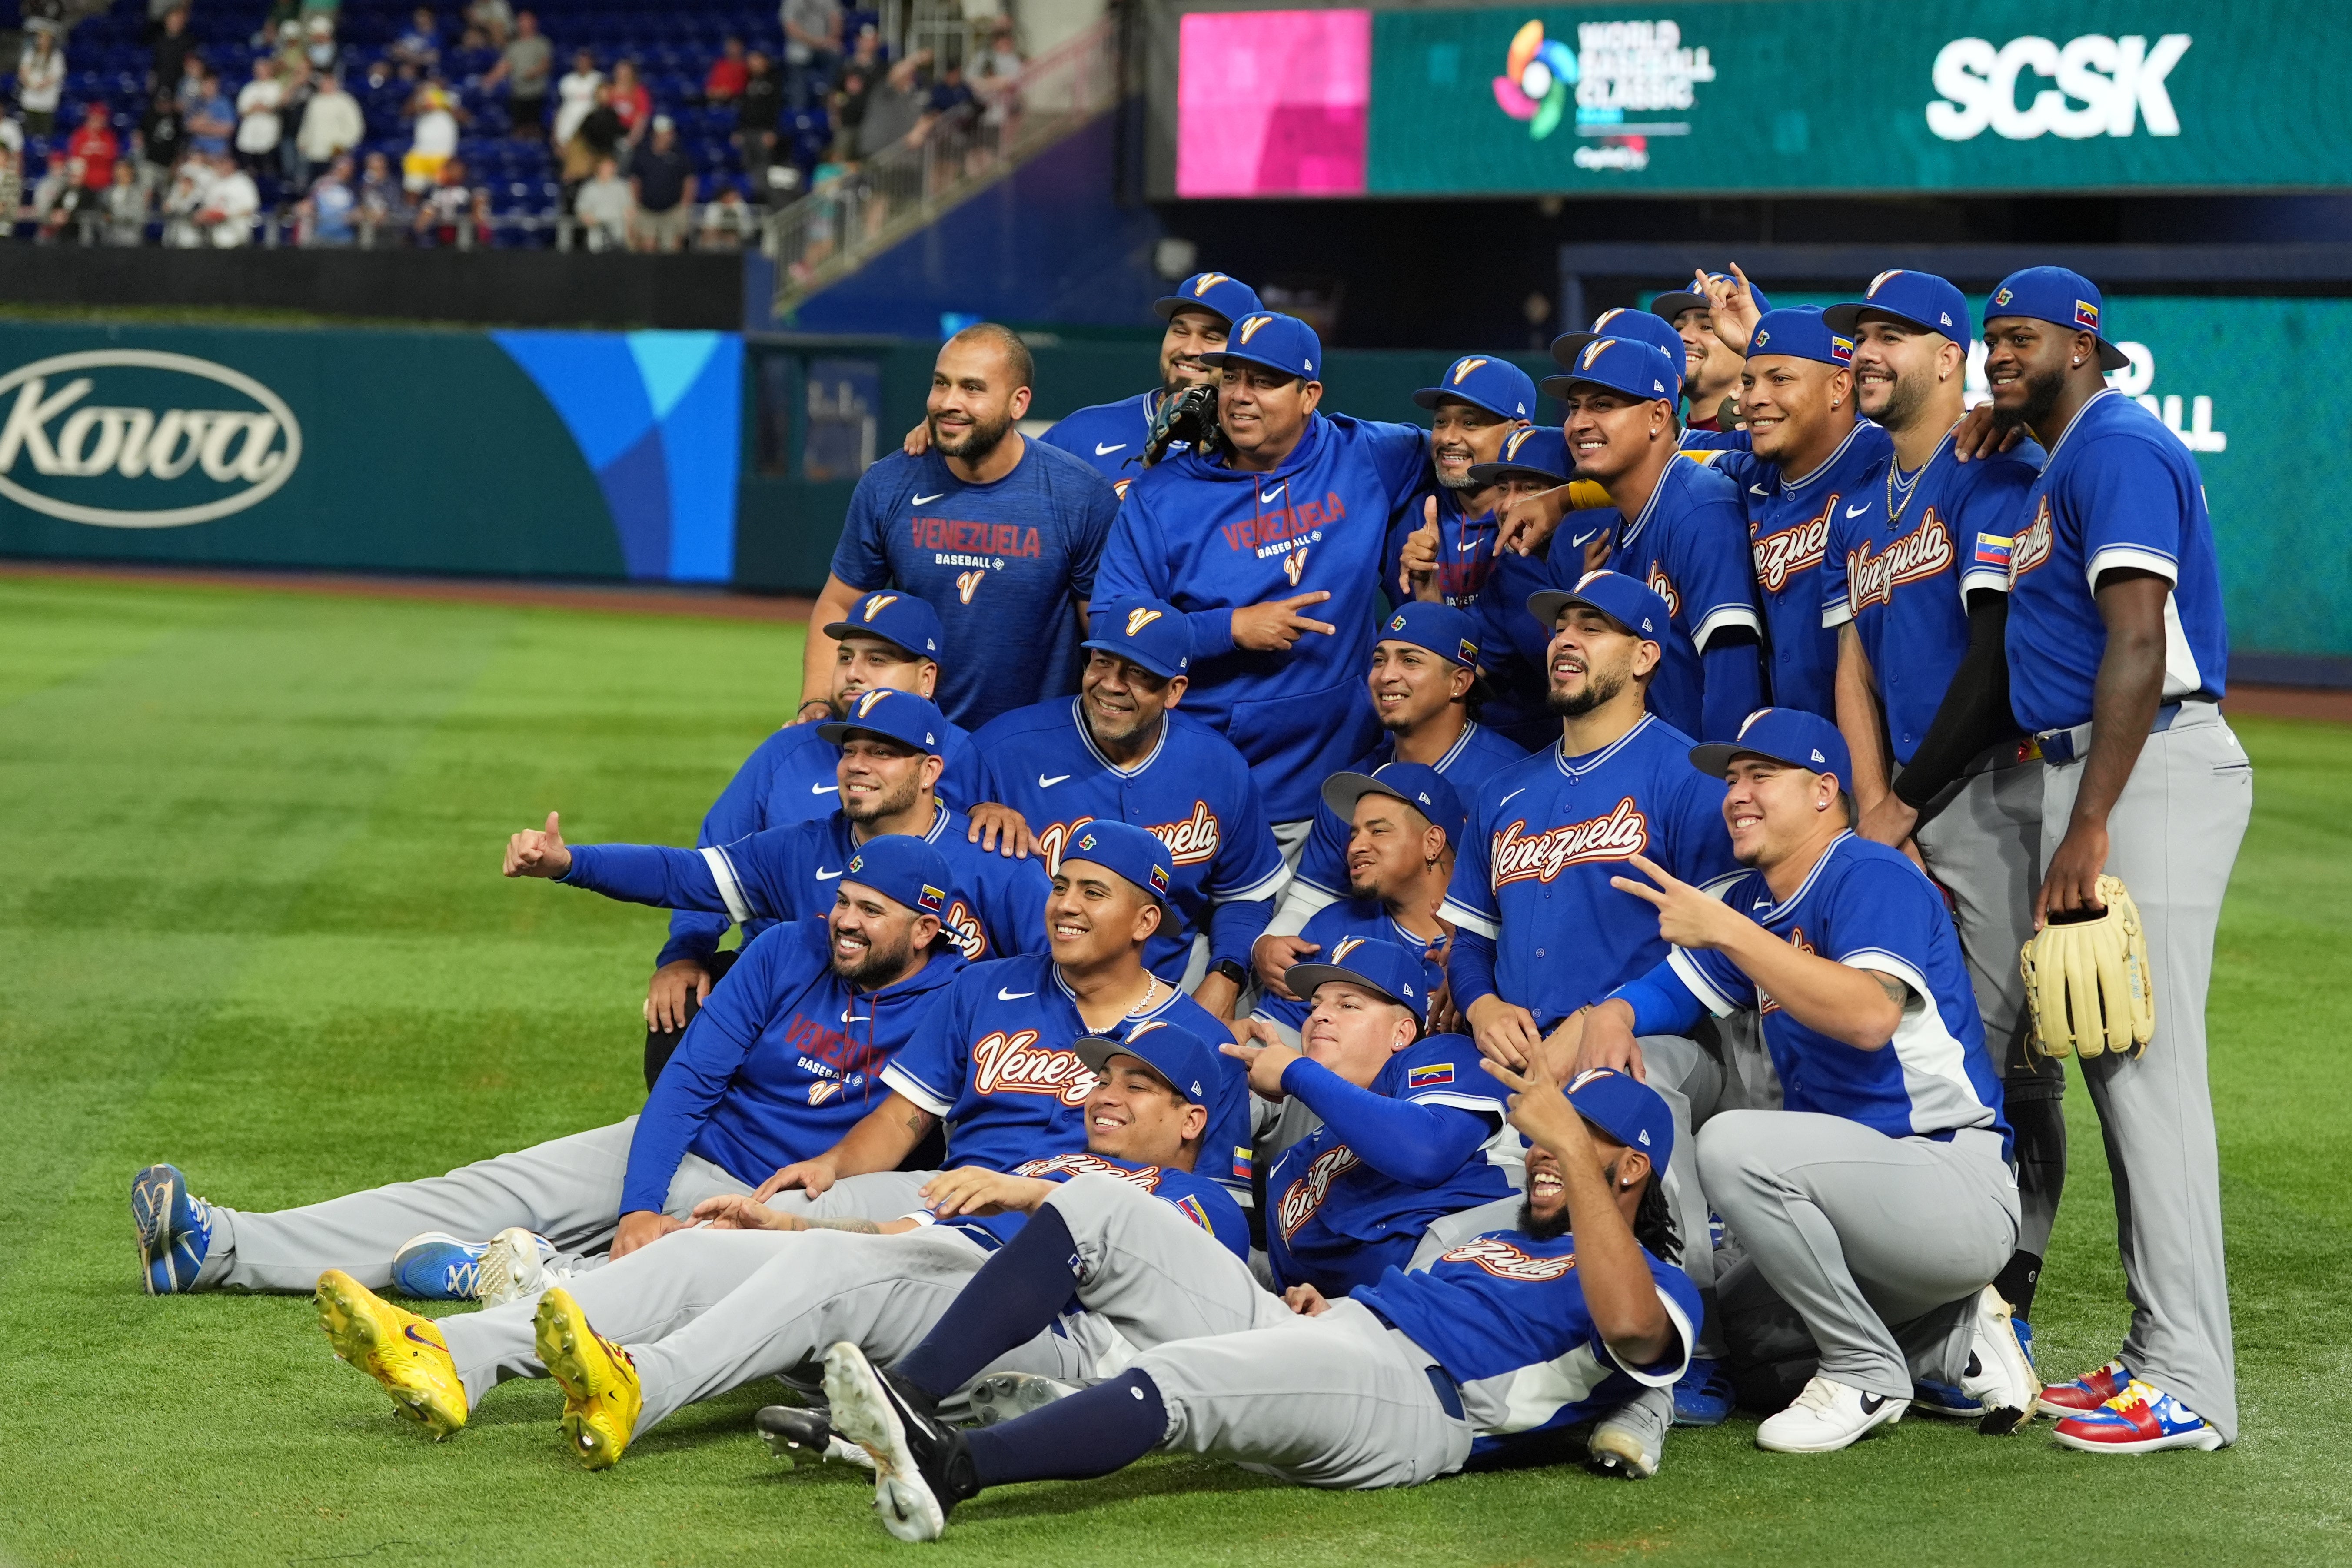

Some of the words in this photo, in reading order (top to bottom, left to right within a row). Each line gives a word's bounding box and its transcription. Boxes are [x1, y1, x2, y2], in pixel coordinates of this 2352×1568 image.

[1926, 34, 2193, 141] SCSK
[1194, 273, 1228, 297] V
[1866, 269, 1903, 300] V
[1240, 316, 1272, 345] V
[1582, 339, 1616, 371] V
[1453, 358, 1487, 385] V
[0, 377, 288, 483] Kowa
[1506, 429, 1536, 462] V
[1221, 492, 1346, 551] VENEZUELA
[912, 517, 1040, 558] VENEZUELA
[1257, 535, 1311, 559] BASEBALL
[935, 553, 991, 569] BASEBALL
[1284, 547, 1308, 586] V
[957, 570, 984, 604] V
[1573, 569, 1613, 594] V
[863, 594, 897, 622] V
[1125, 607, 1162, 637] V
[858, 691, 892, 718] V
[1737, 708, 1772, 741] V
[1491, 797, 1647, 896] Venezuela
[1331, 939, 1364, 965] V
[785, 1013, 889, 1078] VENEZUEL
[1124, 1020, 1168, 1045] V
[973, 1030, 1100, 1106] Venez
[1567, 1068, 1613, 1095] V
[808, 1080, 841, 1106] V
